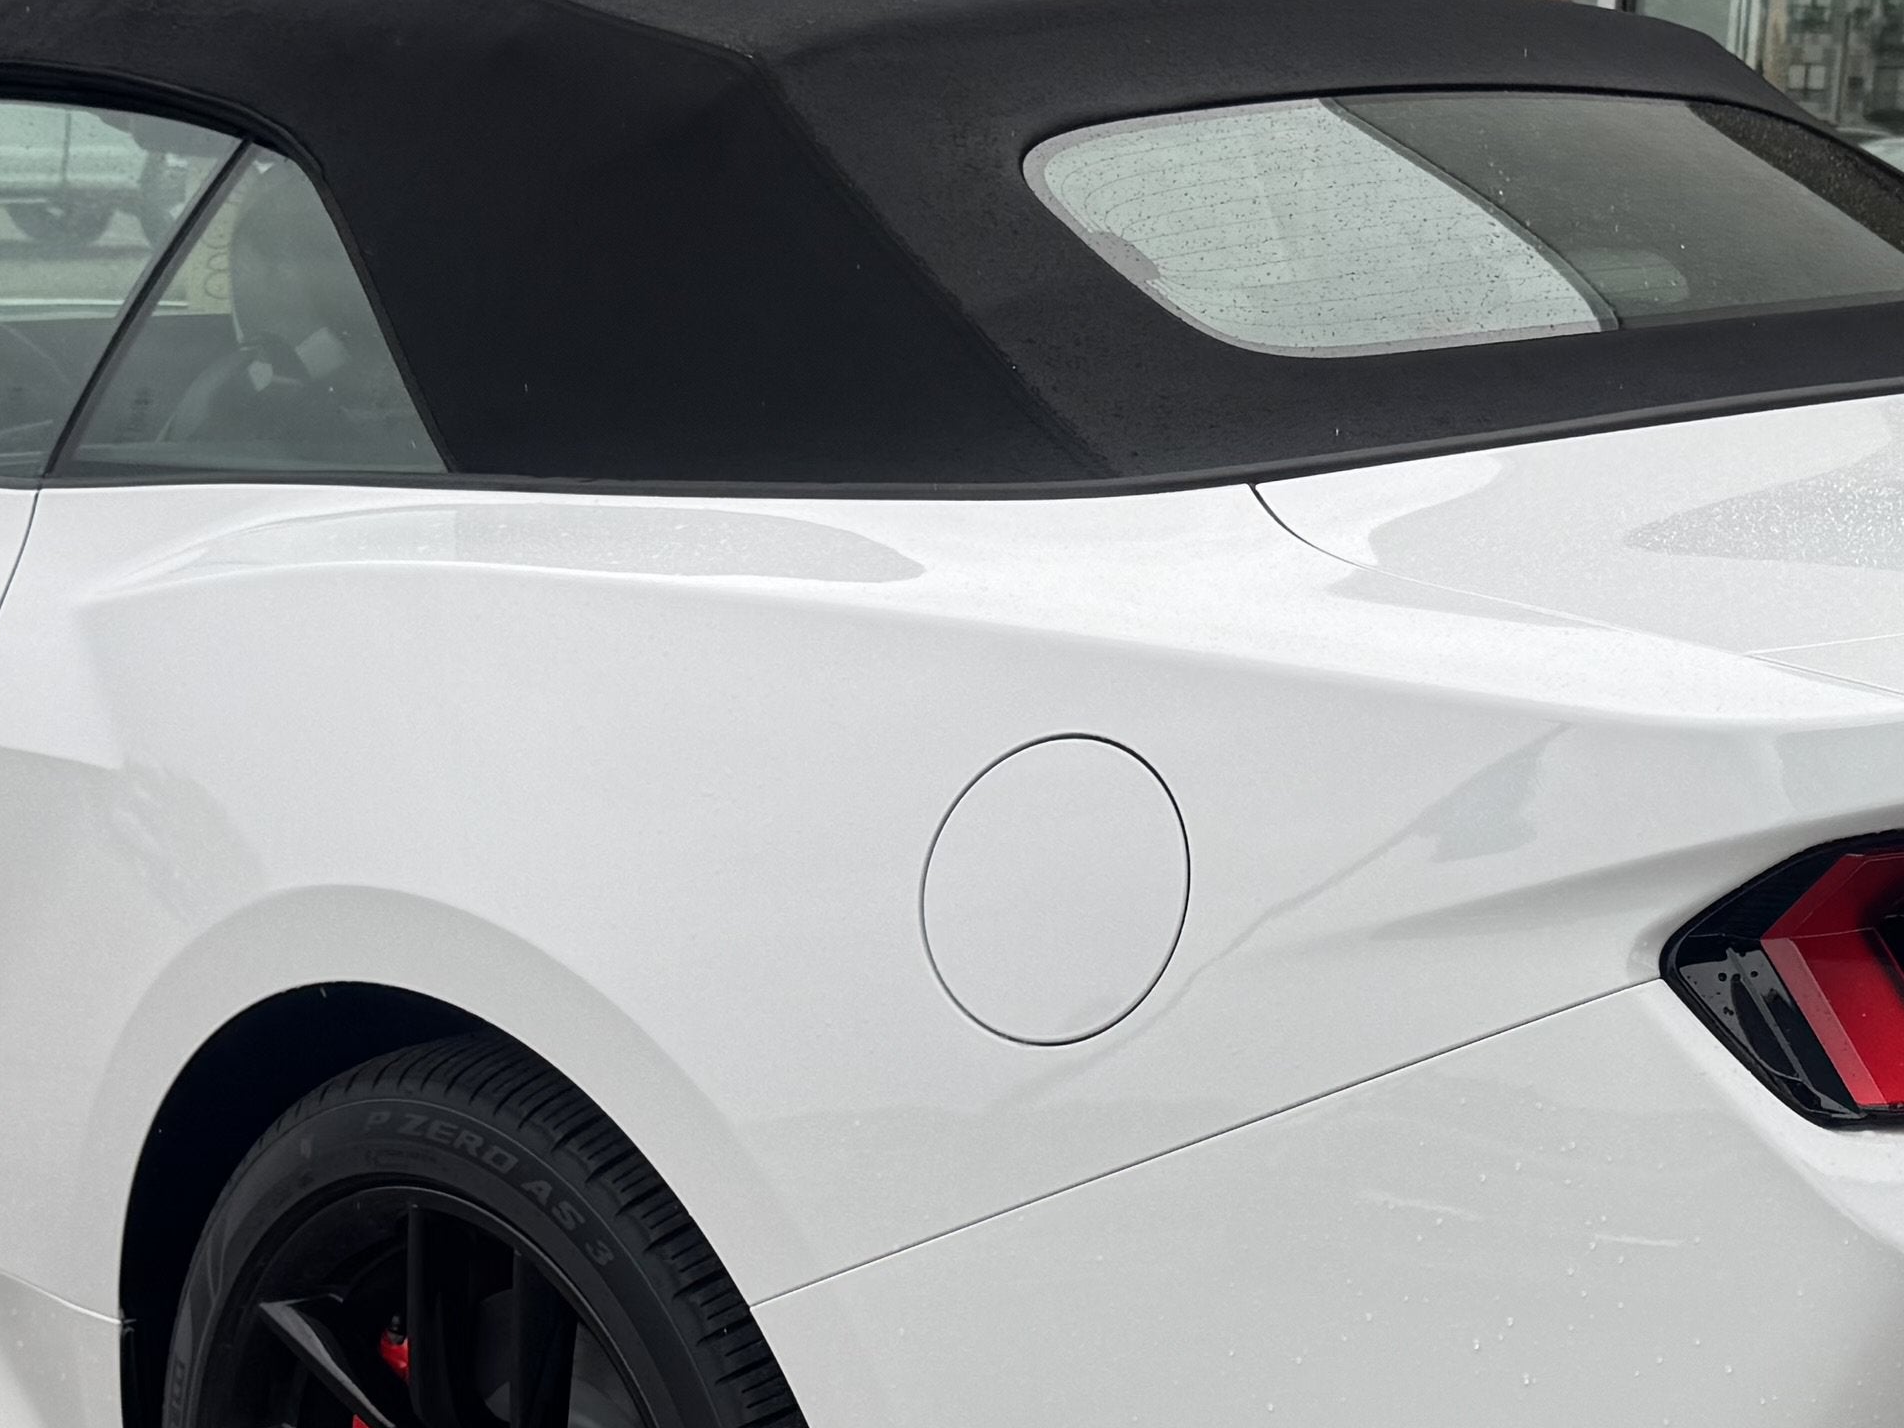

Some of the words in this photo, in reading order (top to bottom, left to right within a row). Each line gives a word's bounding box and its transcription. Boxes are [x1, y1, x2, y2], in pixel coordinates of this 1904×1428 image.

[397, 1113, 519, 1173] ZERO
[520, 1179, 586, 1231] AS
[584, 1239, 615, 1266] 3
